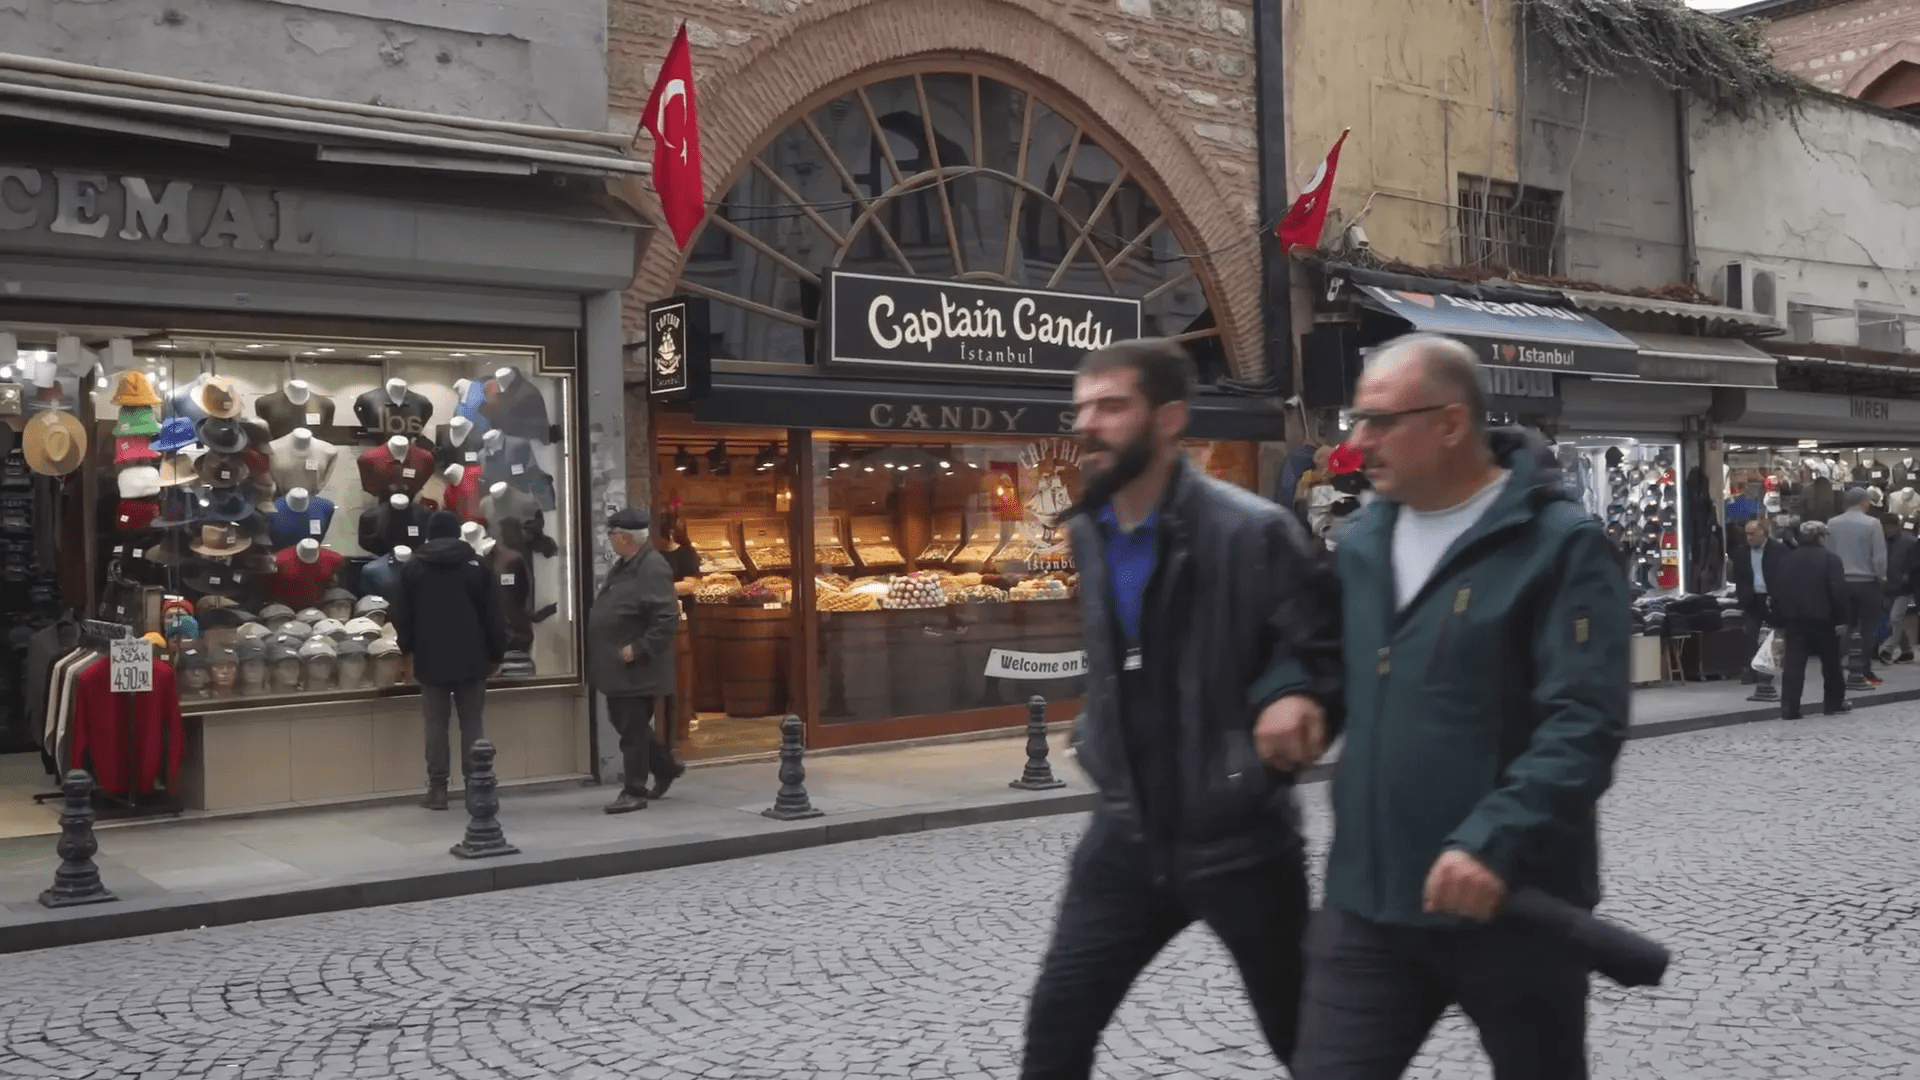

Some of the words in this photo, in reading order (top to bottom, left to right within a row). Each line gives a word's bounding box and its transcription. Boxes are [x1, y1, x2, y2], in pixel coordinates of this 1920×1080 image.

[0, 165, 316, 252] CEMAL
[868, 291, 1007, 352] Captain
[1013, 297, 1113, 350] Candy
[960, 341, 1034, 364] İstanbul
[1518, 346, 1575, 366] Istanbul
[869, 403, 1028, 431] CANDY
[111, 651, 150, 664] KAZAK
[1001, 654, 1059, 673] Welcome
[1062, 660, 1078, 671] on
